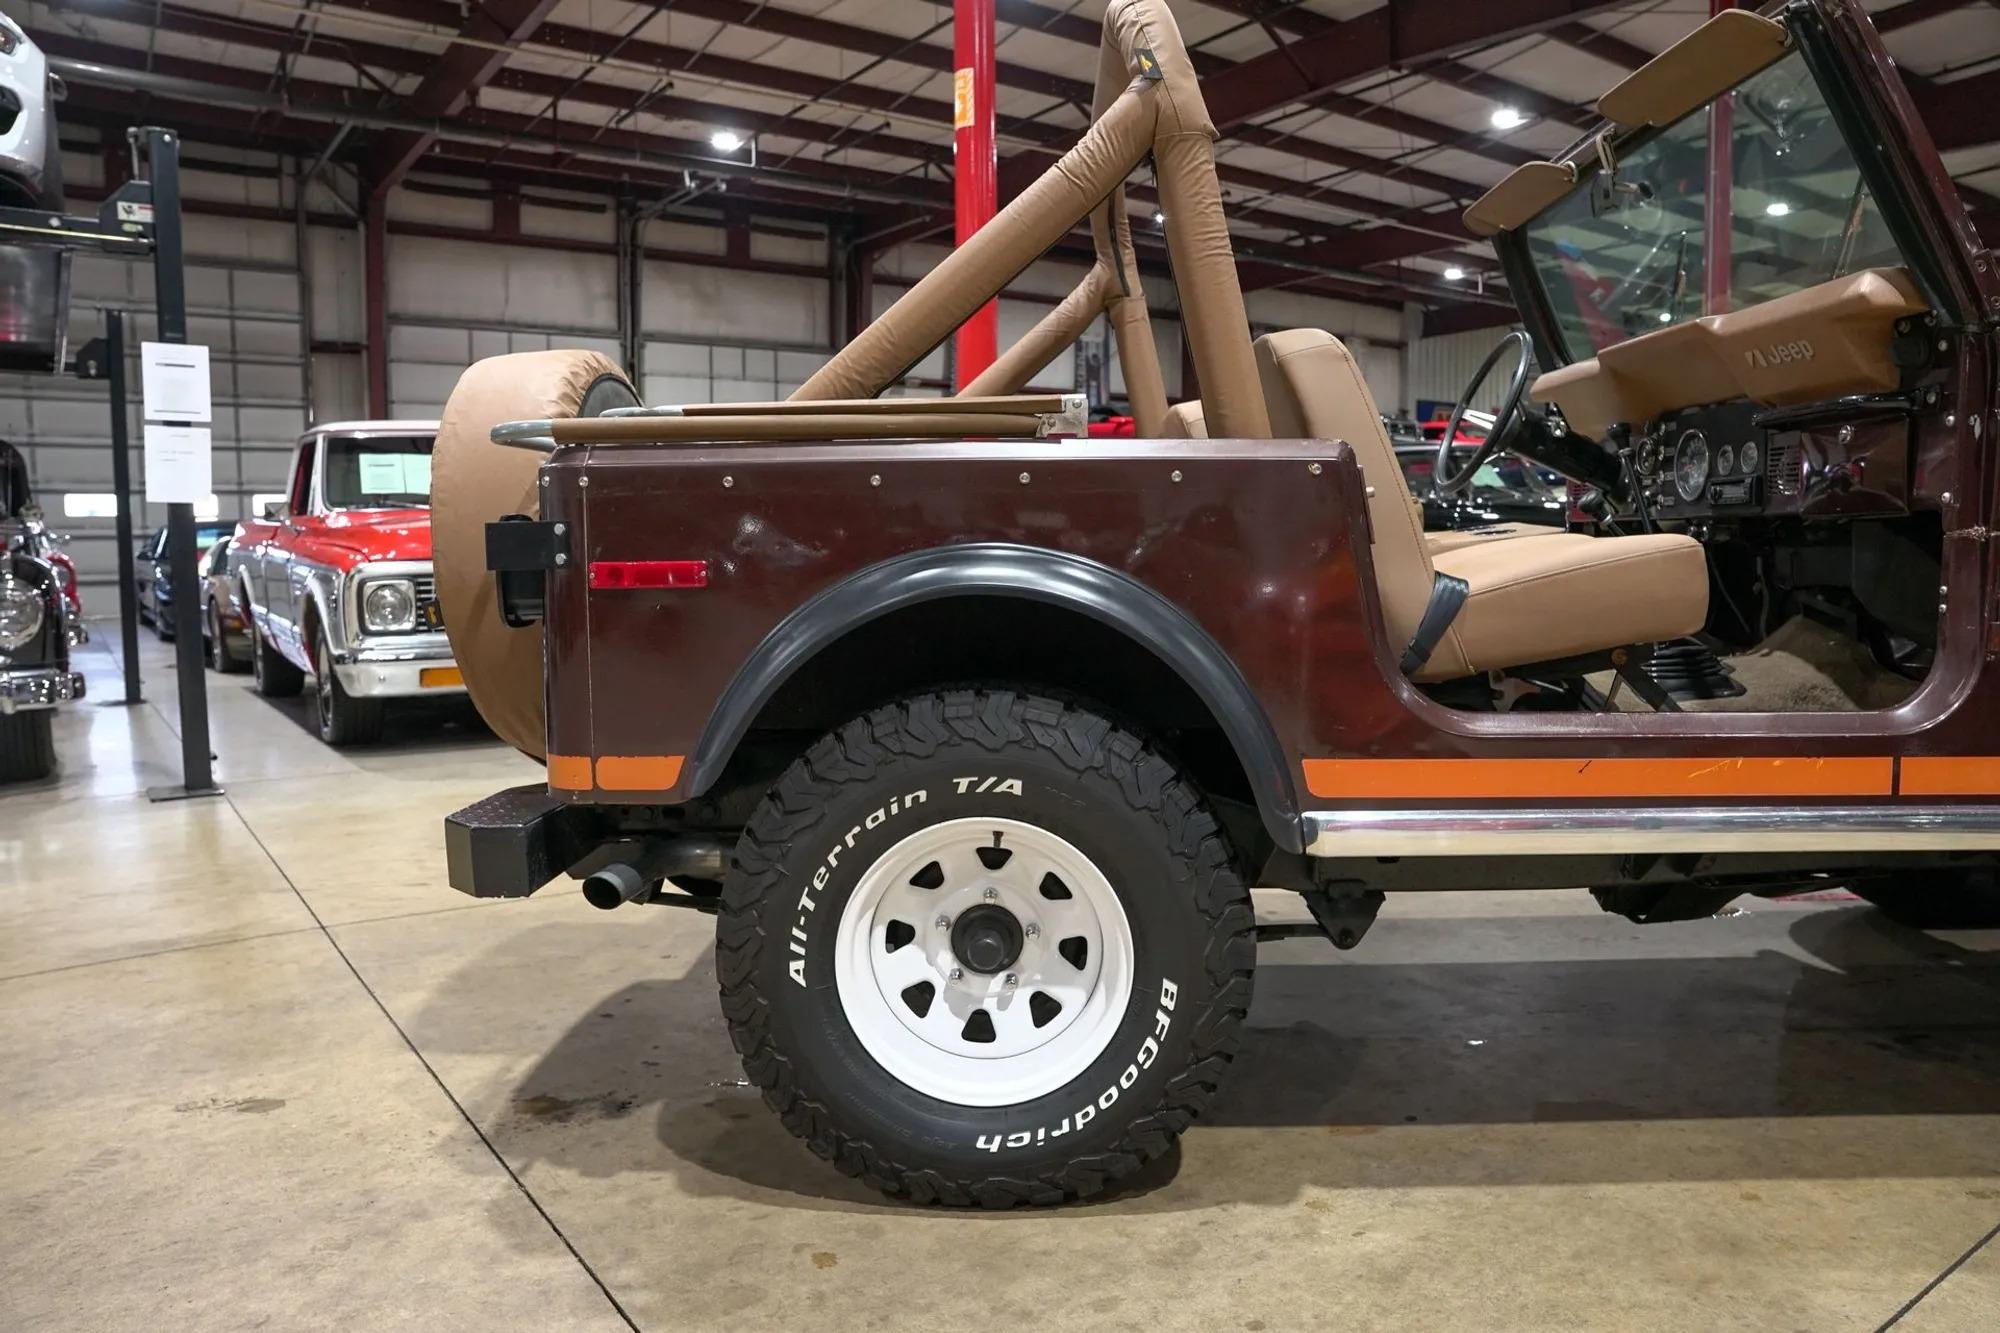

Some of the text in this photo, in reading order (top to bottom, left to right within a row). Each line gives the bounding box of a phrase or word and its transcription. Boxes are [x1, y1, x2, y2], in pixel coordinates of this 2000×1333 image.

[1768, 340, 1814, 364] Jeep
[788, 776, 1023, 988] All-Terrain T/A
[975, 977, 1179, 1153] BFGoodrich
